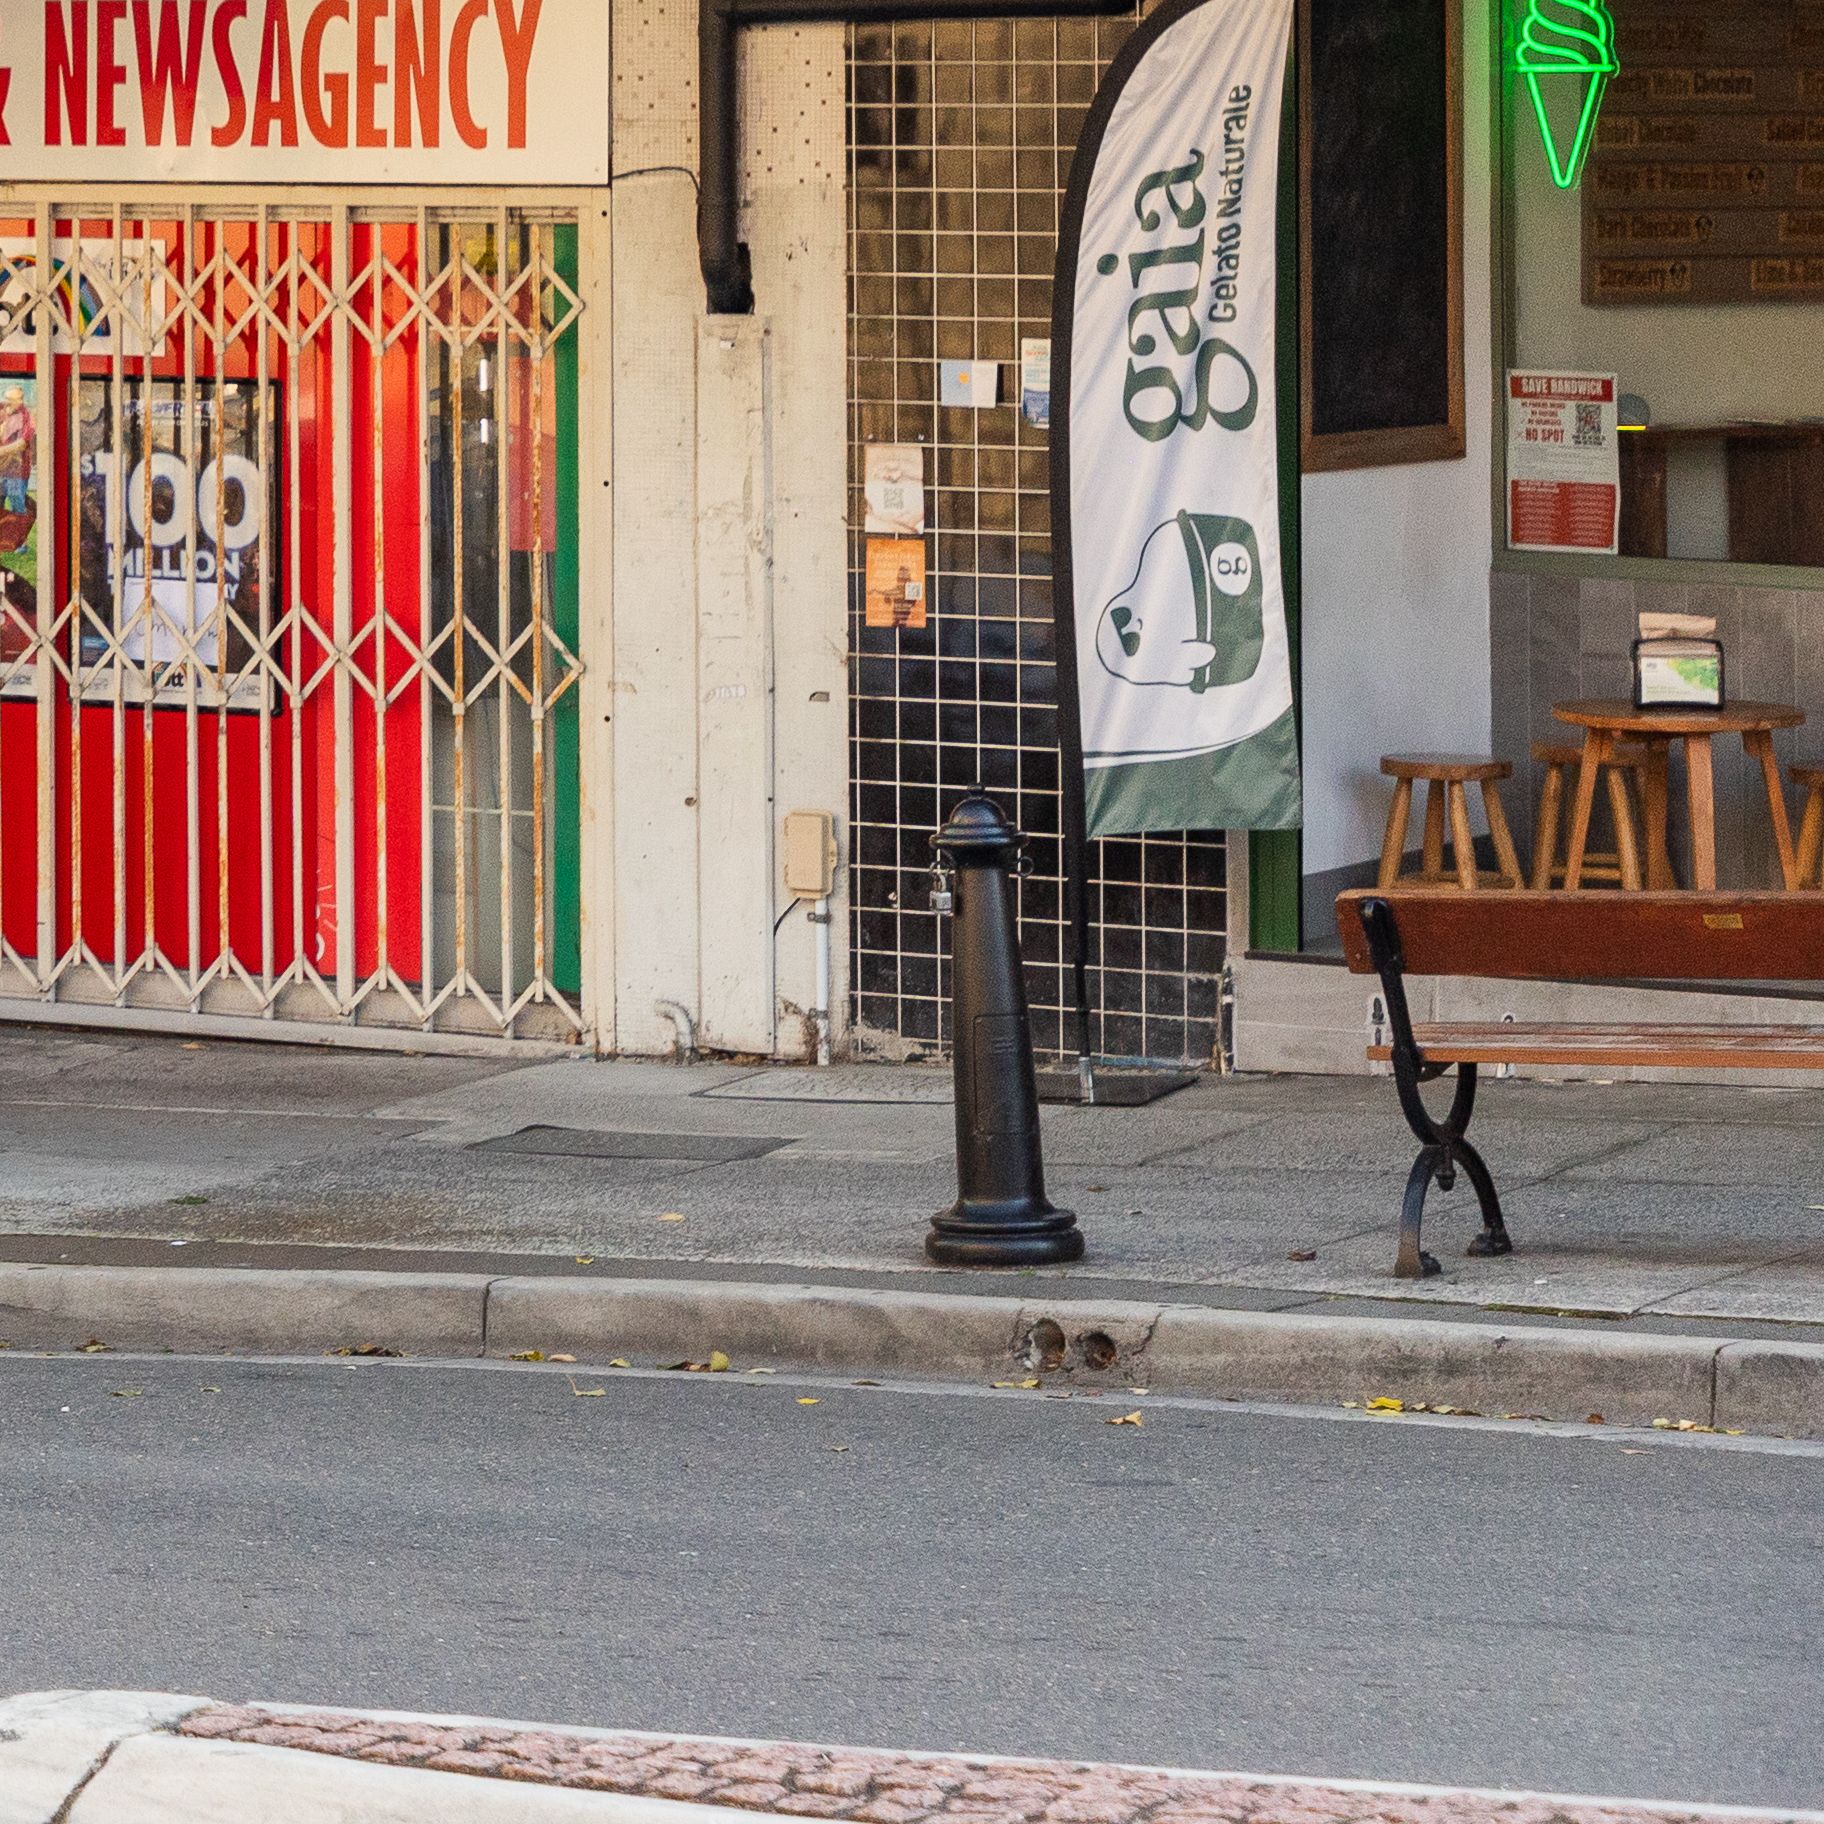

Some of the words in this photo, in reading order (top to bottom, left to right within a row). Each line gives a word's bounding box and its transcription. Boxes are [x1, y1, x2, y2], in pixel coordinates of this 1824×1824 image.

[1213, 82, 1253, 220] Naturale
[1097, 146, 1260, 445] gaia
[1209, 221, 1240, 326] Gelato
